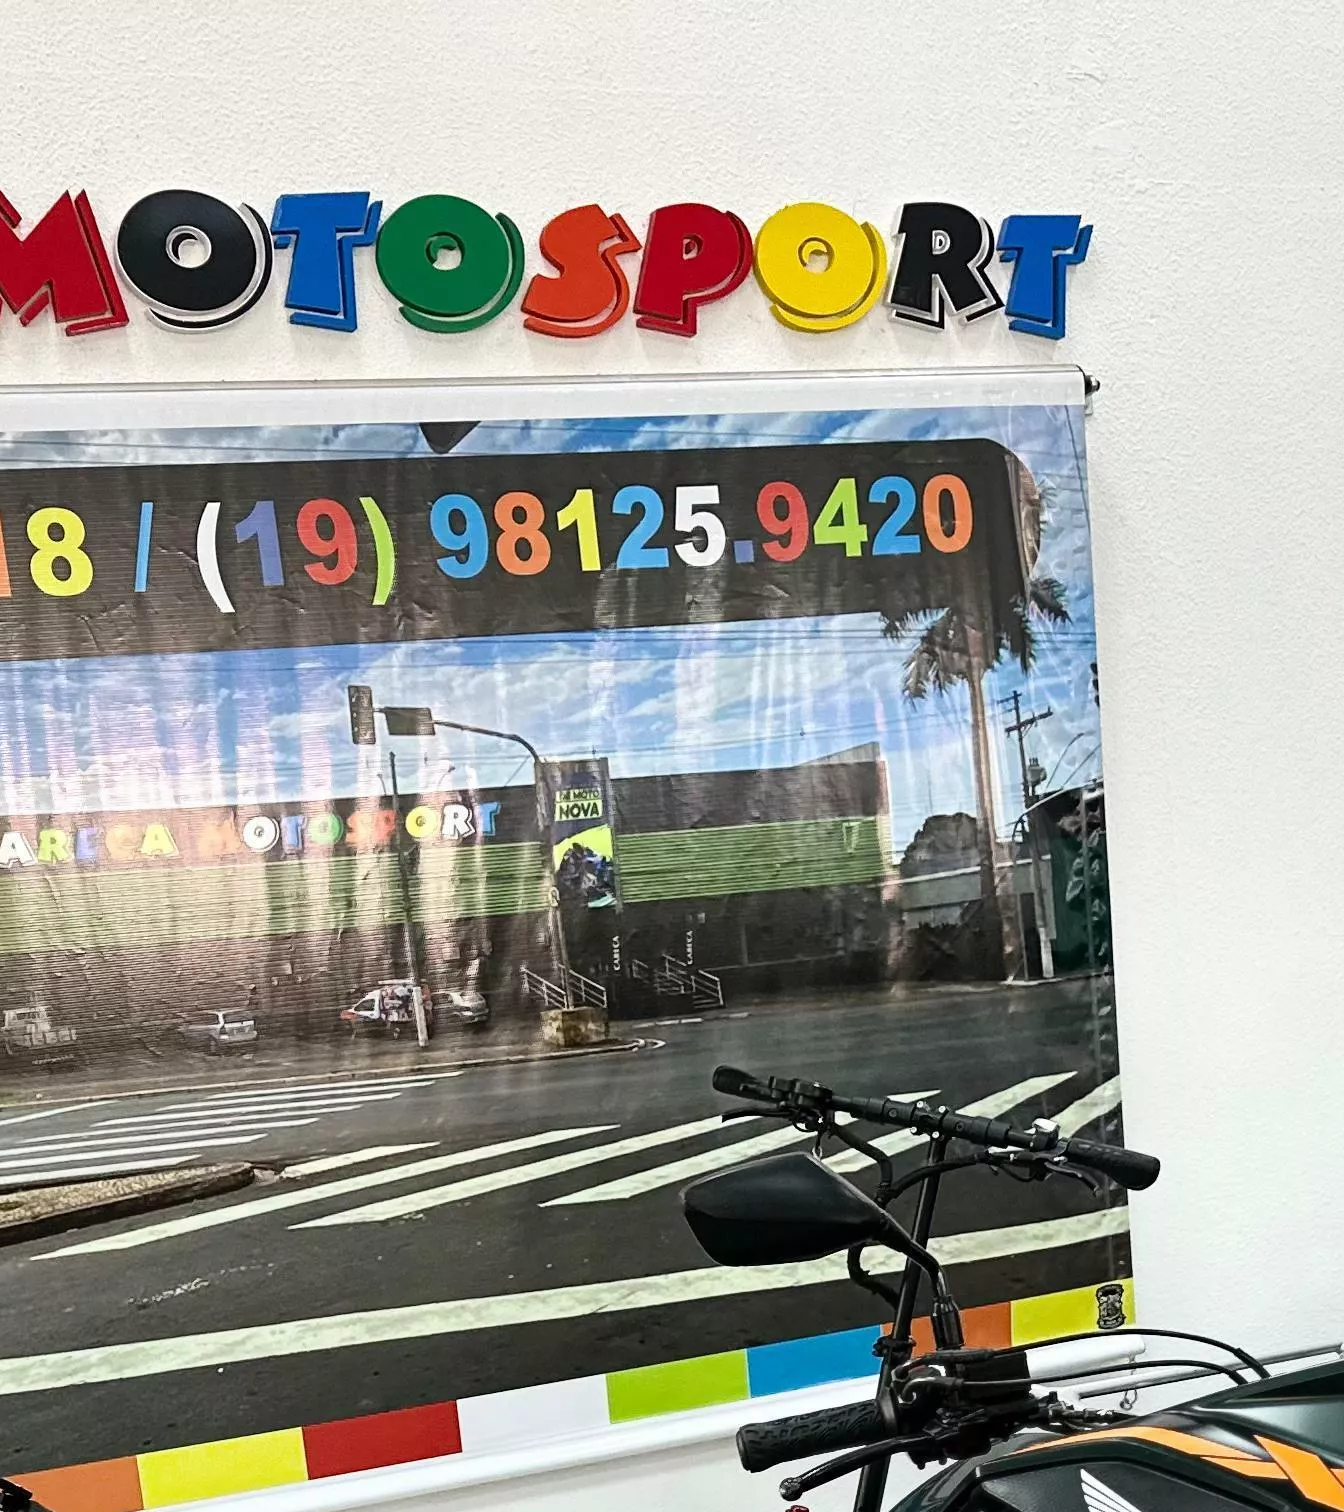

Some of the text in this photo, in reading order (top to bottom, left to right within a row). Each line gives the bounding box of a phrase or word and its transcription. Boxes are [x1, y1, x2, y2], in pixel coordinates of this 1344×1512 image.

[197, 496, 397, 613] (19)
[429, 472, 973, 578] 98125.9420
[559, 802, 600, 819] NOVA
